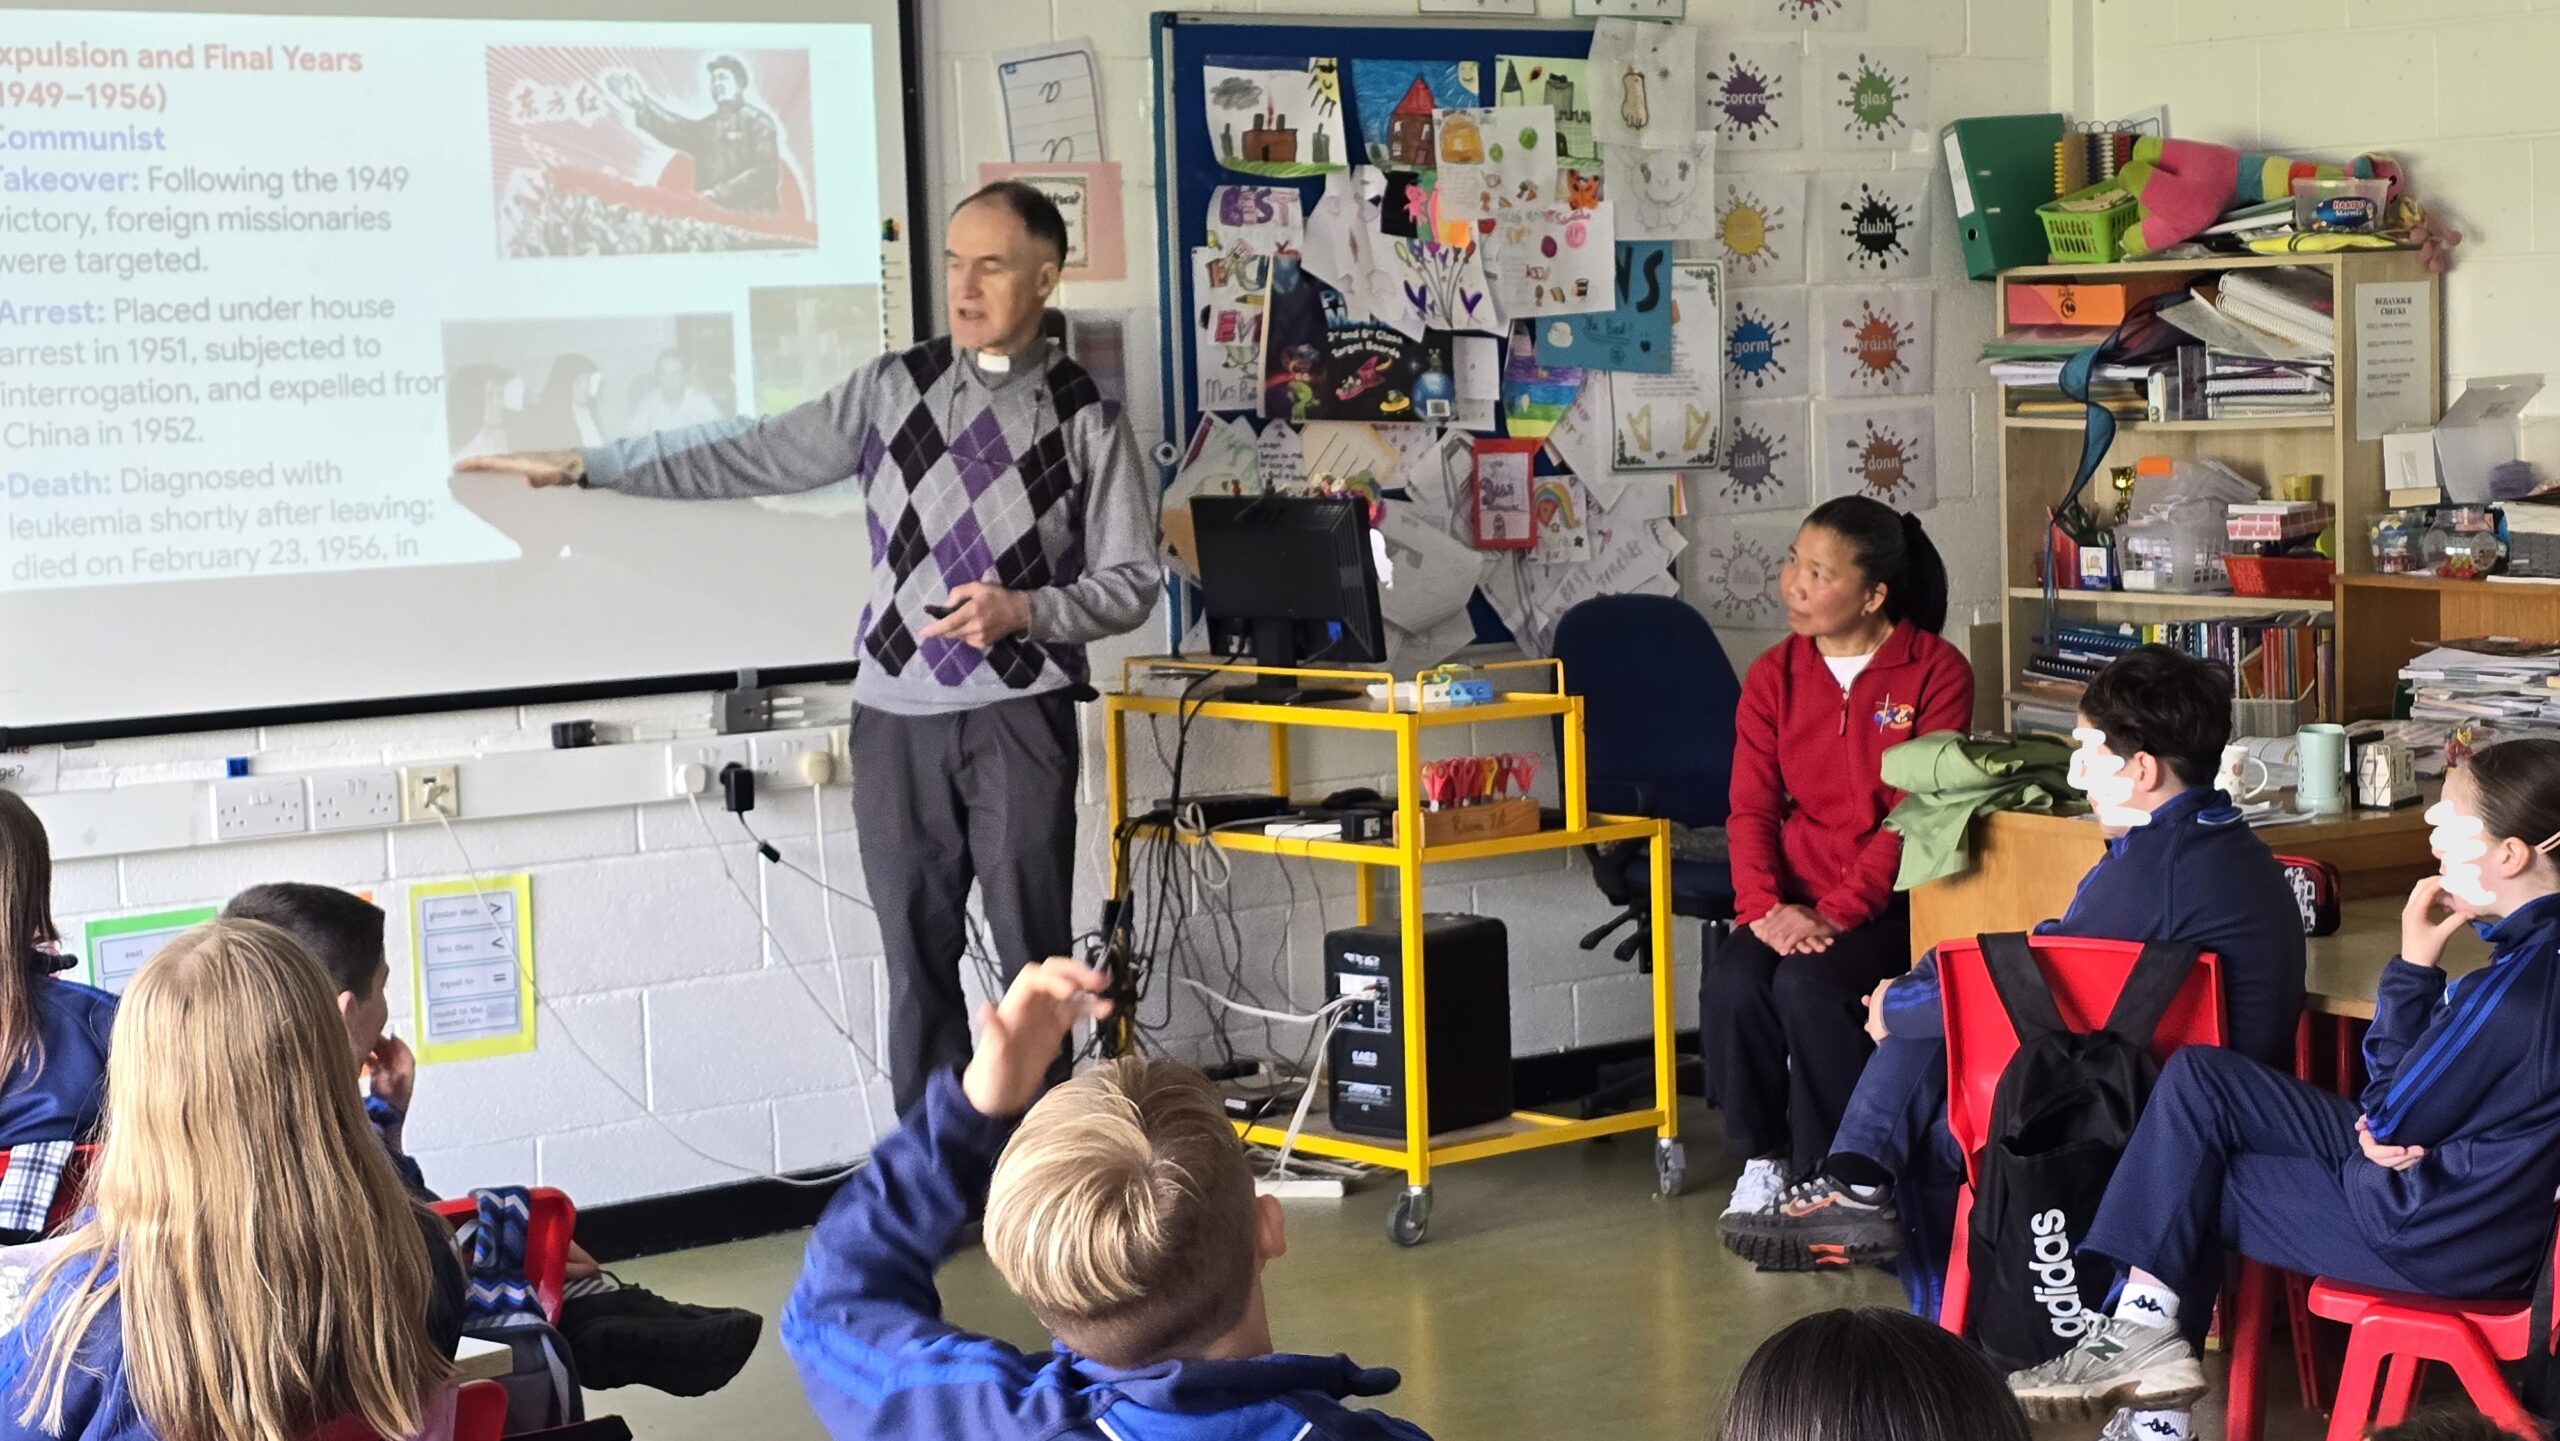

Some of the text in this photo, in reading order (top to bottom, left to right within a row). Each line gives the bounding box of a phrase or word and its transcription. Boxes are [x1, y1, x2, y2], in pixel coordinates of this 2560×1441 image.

[138, 45, 195, 70] and
[204, 43, 273, 71] Final
[282, 46, 363, 73] Years
[1724, 92, 1767, 105] corcra
[1860, 90, 1887, 109] glas
[0, 165, 409, 199] akeover: Following the 1949
[106, 205, 210, 239] foreign
[218, 205, 391, 232] missionaries
[1859, 218, 1893, 234] dubh
[75, 247, 209, 281] targeted.
[0, 295, 395, 325] Arrest: Placed under house
[1, 334, 381, 368] arrest in 1951, subjected to
[1733, 340, 1770, 358] gorm
[1, 378, 200, 412] interrogation,
[208, 376, 261, 403] and
[269, 372, 386, 406] expelled
[3, 416, 204, 449] China in 1952.
[1734, 450, 1765, 469] liath
[1867, 455, 1900, 470] donn
[120, 464, 275, 498] Diagnosed
[282, 460, 342, 486] with
[8, 508, 142, 540] leukemia
[150, 504, 249, 534] shortly
[256, 499, 323, 527] after
[12, 533, 419, 582] died on February 23, 1956, in
[2029, 1208, 2087, 1338] adidas
